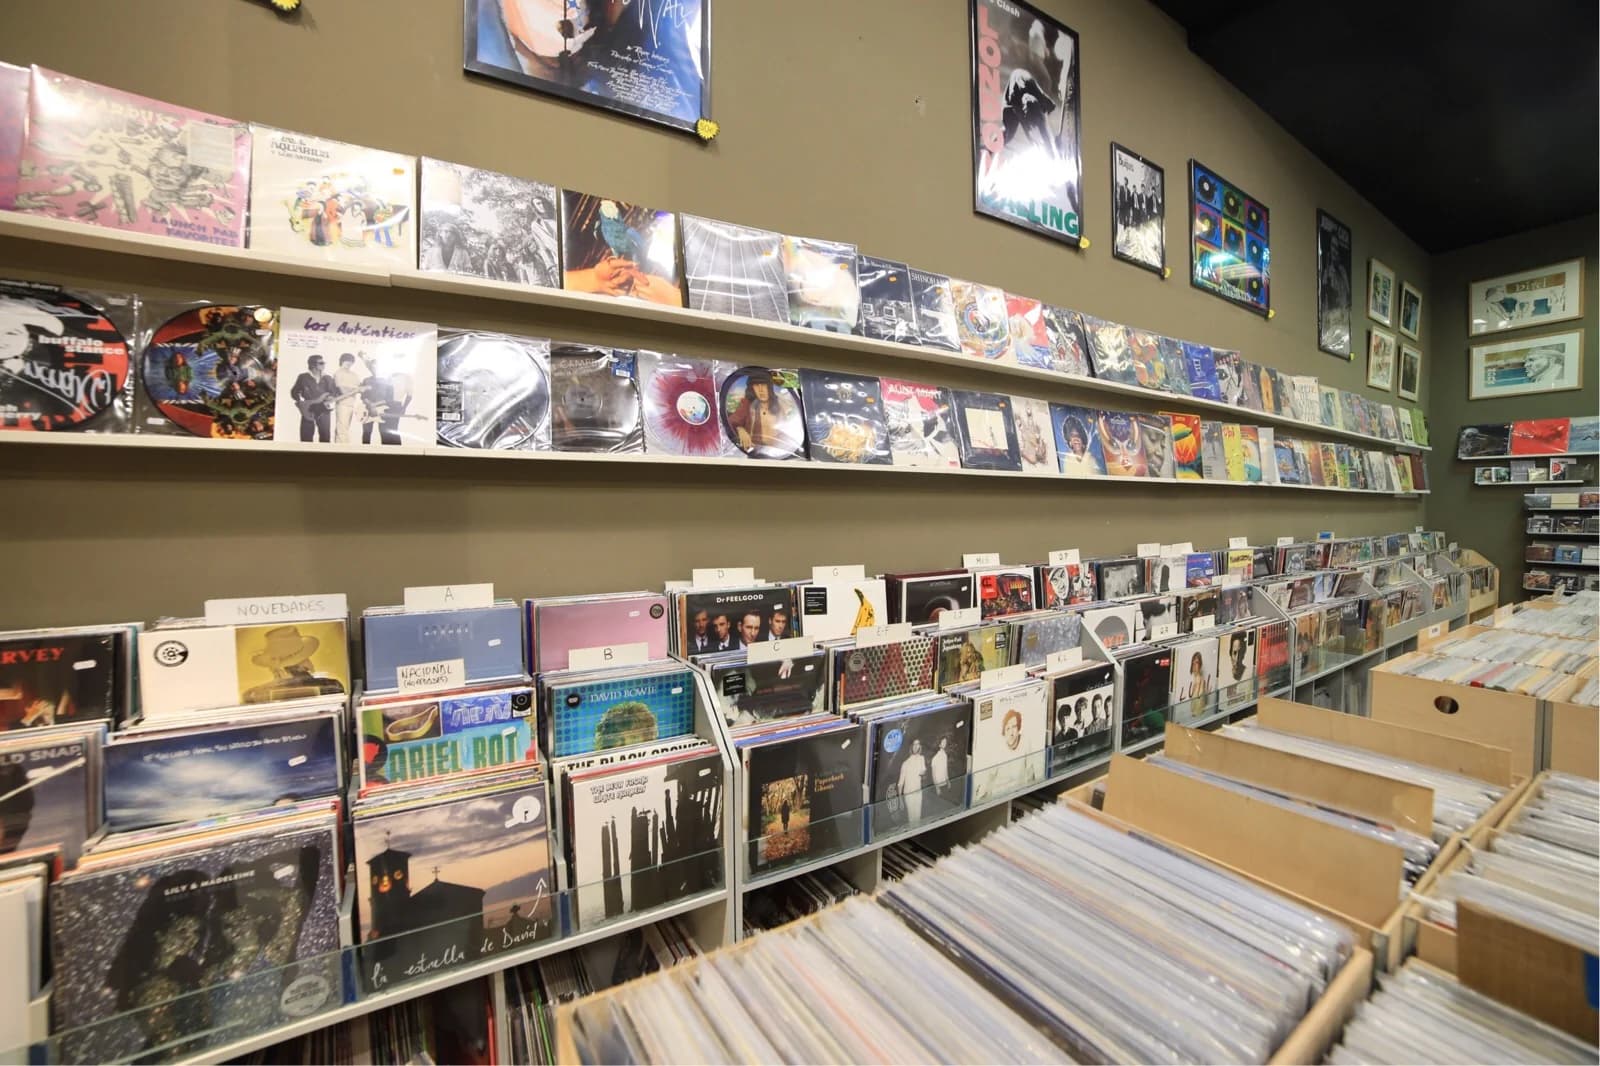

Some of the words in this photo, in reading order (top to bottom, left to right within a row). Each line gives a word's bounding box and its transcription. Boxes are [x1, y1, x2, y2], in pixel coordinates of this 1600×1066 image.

[996, 0, 1020, 18] Clash
[151, 216, 207, 232] LAUNCH
[166, 228, 240, 248] FAVORITES
[38, 335, 105, 347] buffalo
[64, 345, 125, 355] stance
[444, 587, 455, 602] A
[726, 594, 764, 603] FEELGOOD
[237, 600, 326, 617] NOVEDADES
[603, 647, 613, 661] B
[400, 664, 455, 679] NACIONAL
[590, 691, 622, 703] DAVID
[624, 686, 657, 697] BOWIE
[30, 745, 82, 762] SNAP
[389, 740, 462, 782] ARIEL
[473, 731, 519, 770] ROT
[164, 885, 188, 896] LILY
[200, 870, 255, 888] MADELEINE
[404, 945, 465, 976] estrella
[480, 938, 494, 954] de
[502, 921, 538, 949] David
